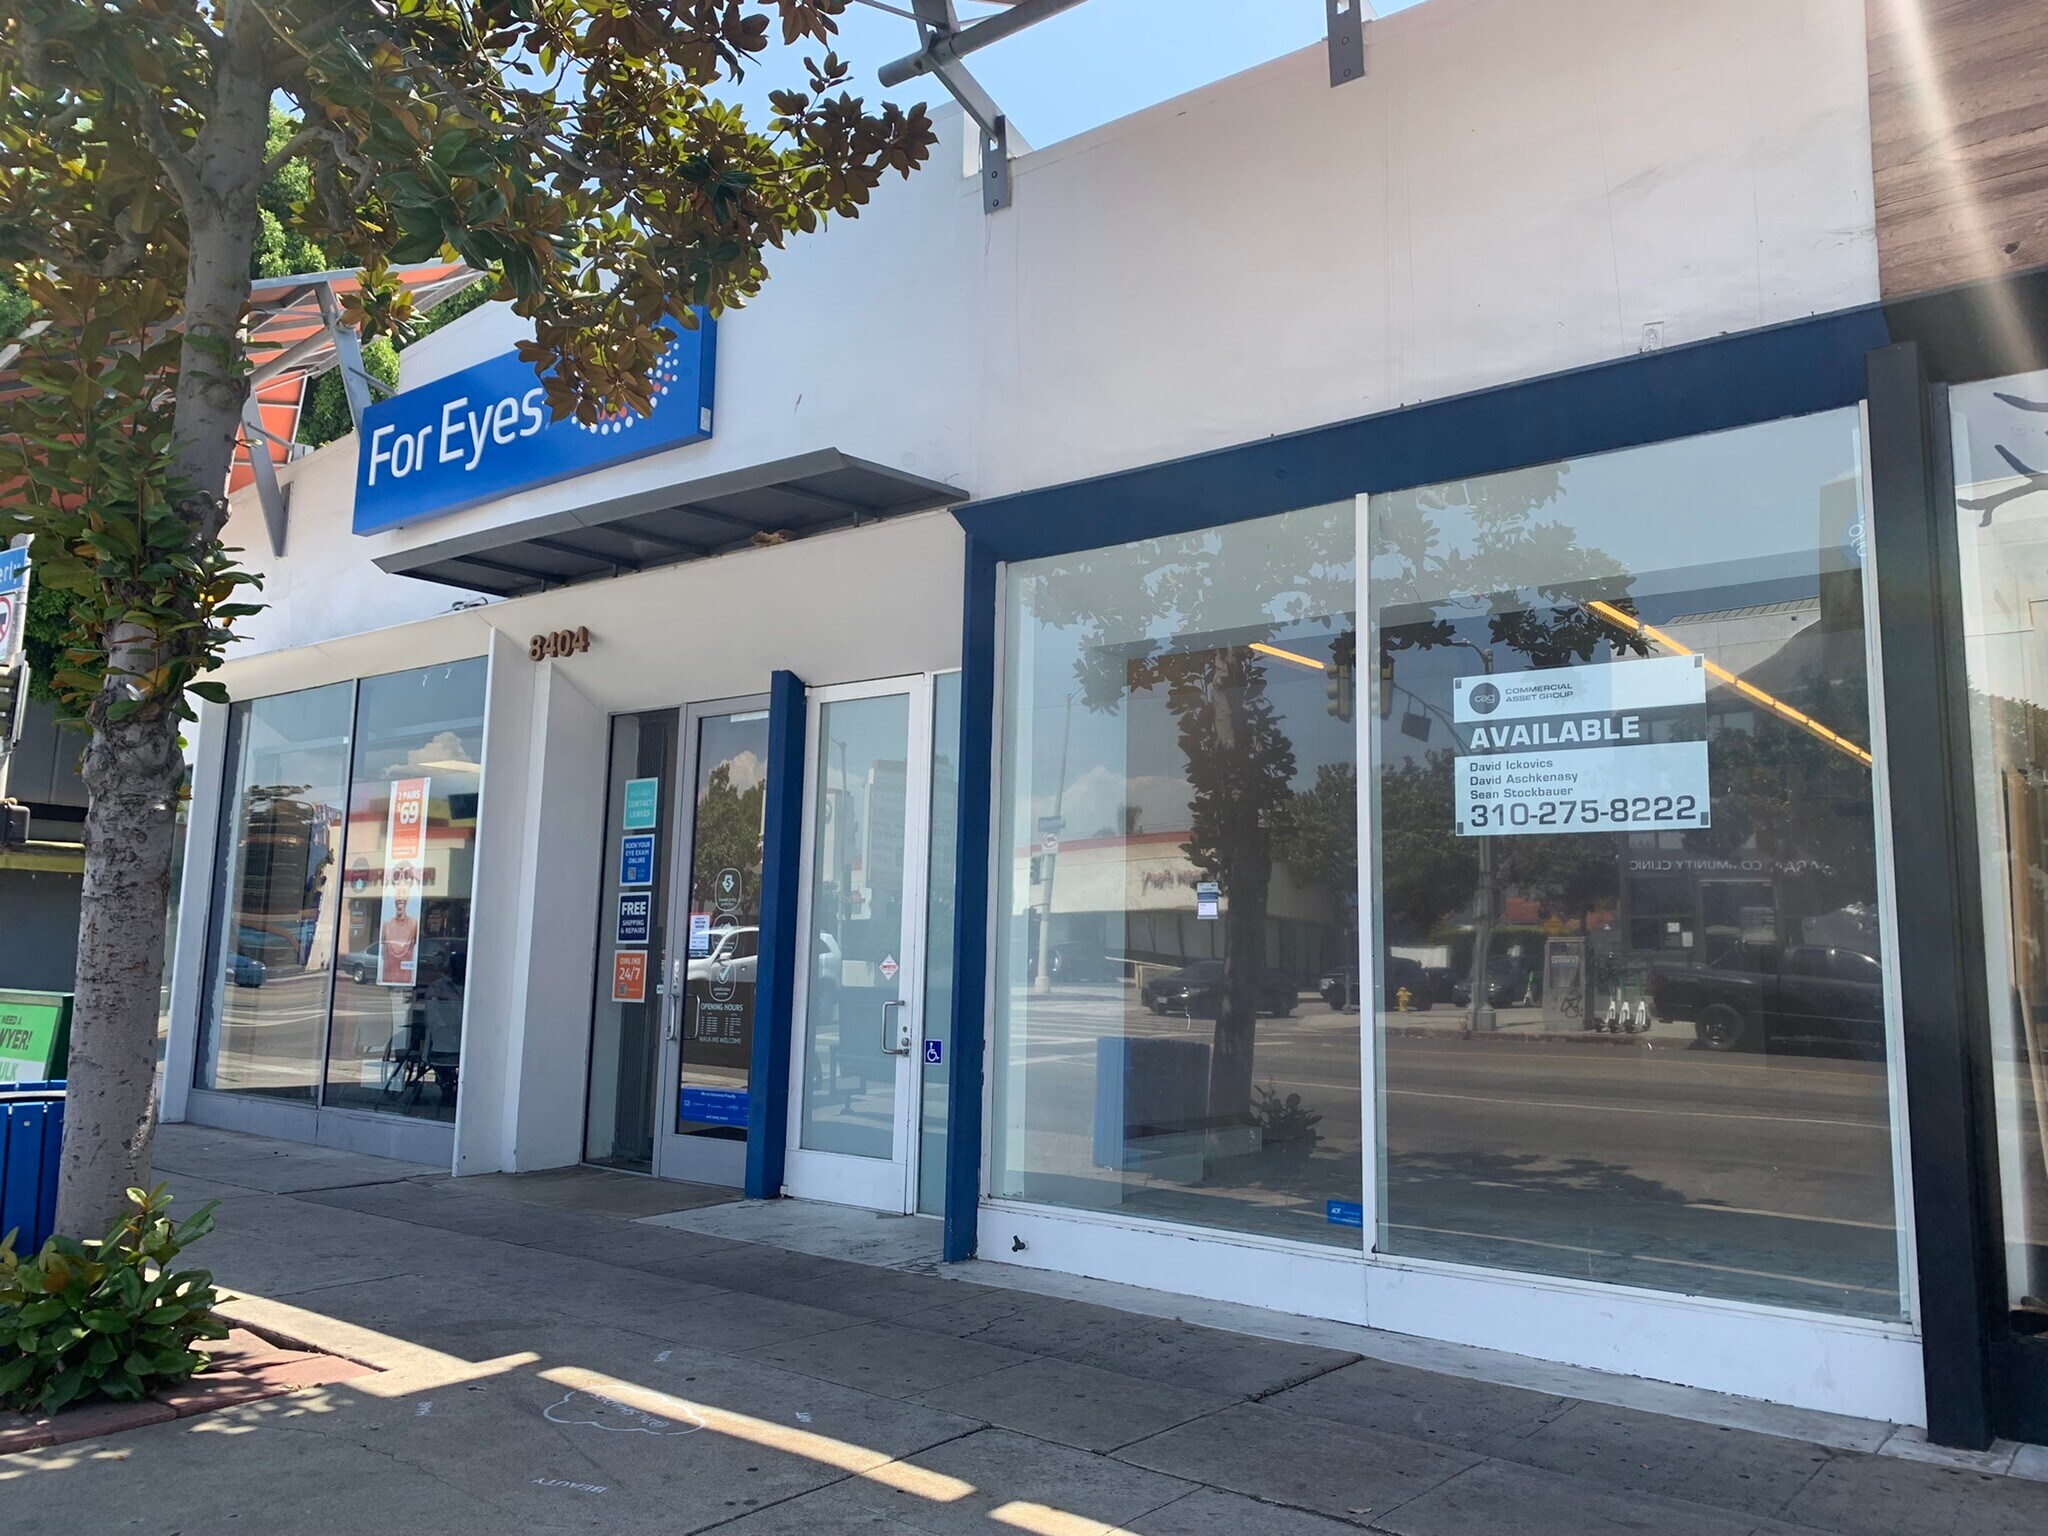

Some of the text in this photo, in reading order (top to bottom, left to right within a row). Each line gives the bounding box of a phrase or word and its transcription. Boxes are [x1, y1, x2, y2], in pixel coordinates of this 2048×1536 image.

[368, 387, 544, 487] For Eyes
[528, 626, 591, 662] 8404
[1505, 682, 1573, 695] COMMERCIAL
[1505, 690, 1574, 703] ASSET GROUP
[1469, 715, 1641, 749] AVAILABLE
[1469, 759, 1553, 772] David Ickovics
[1469, 771, 1579, 786] David Aschkenasy
[402, 789, 421, 800] PAIRS
[1470, 785, 1574, 800] Sean Stockbauer
[628, 799, 653, 808] CONTACT
[629, 809, 651, 818] LENSES
[1470, 795, 1697, 828] 310-275-8222
[635, 848, 650, 856] EXAM
[621, 901, 647, 916] FREE
[622, 919, 645, 927] SHIPPING
[625, 926, 646, 935] REPAIRS
[619, 957, 642, 965] ONLINE
[618, 966, 641, 982] 24/7
[700, 1003, 744, 1012] OPENING HOURS
[530, 1477, 608, 1494] BEAUTY
